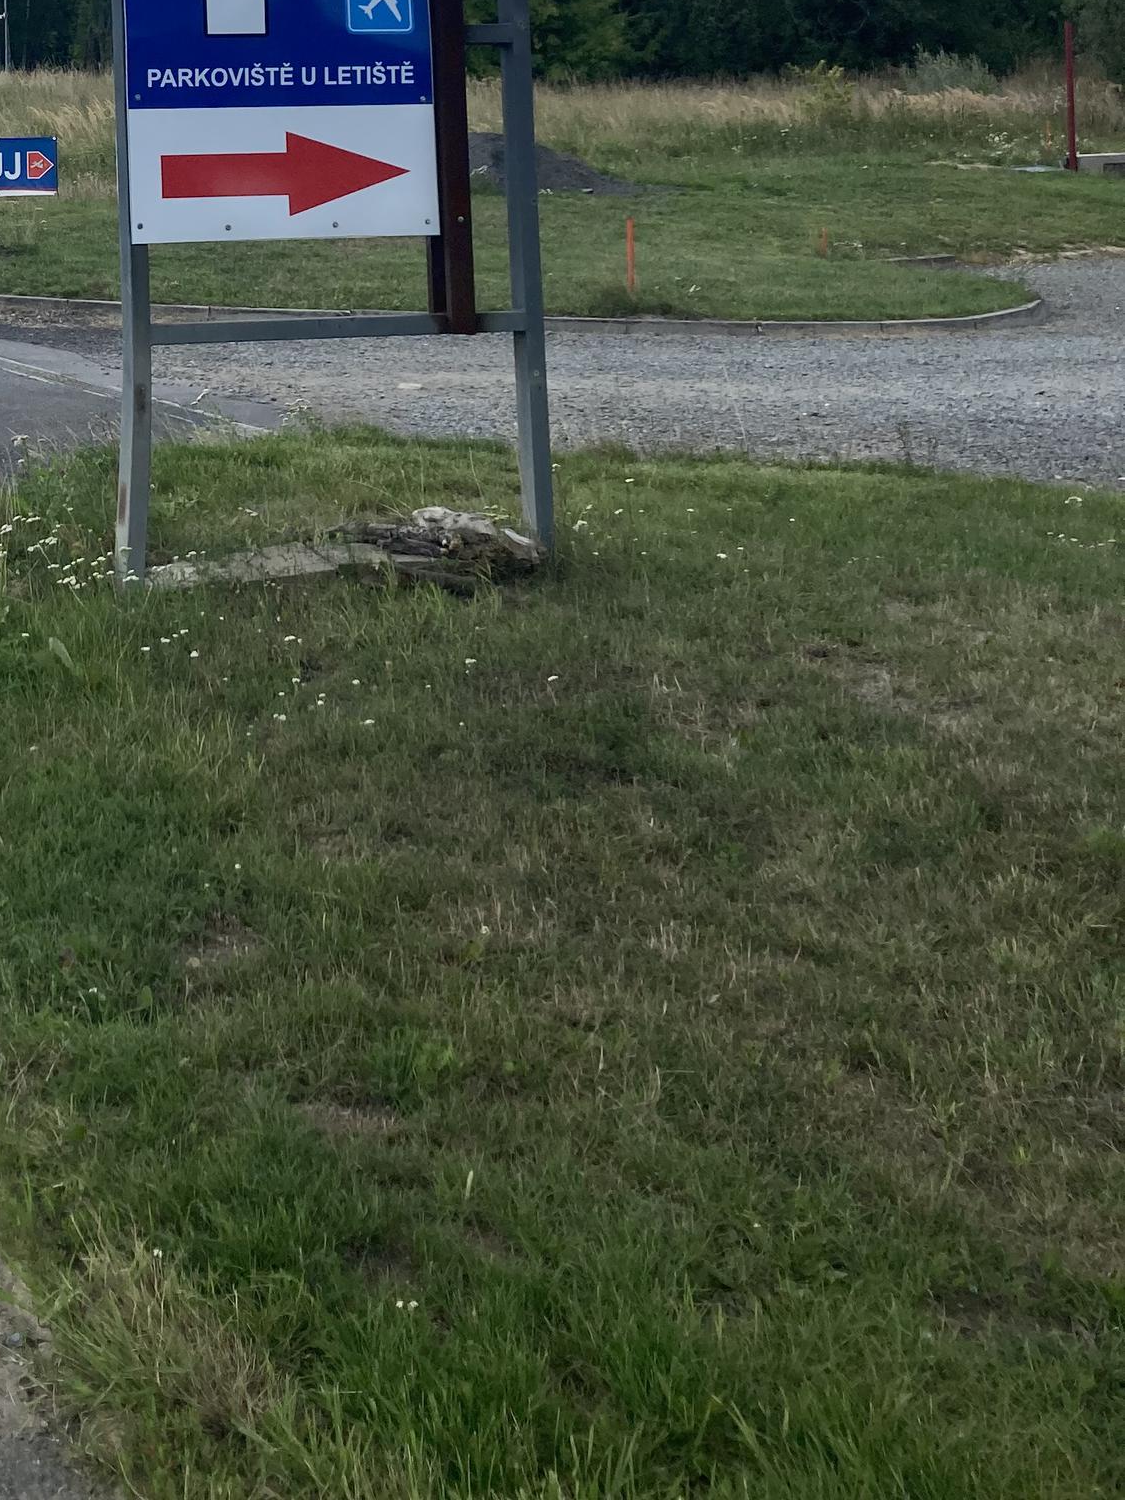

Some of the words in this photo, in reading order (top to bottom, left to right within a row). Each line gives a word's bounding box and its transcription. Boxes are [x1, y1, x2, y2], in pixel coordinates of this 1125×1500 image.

[147, 63, 294, 88] PARKOVIŠTĚ
[301, 67, 316, 85] U
[324, 61, 415, 85] LETIŠTĚ
